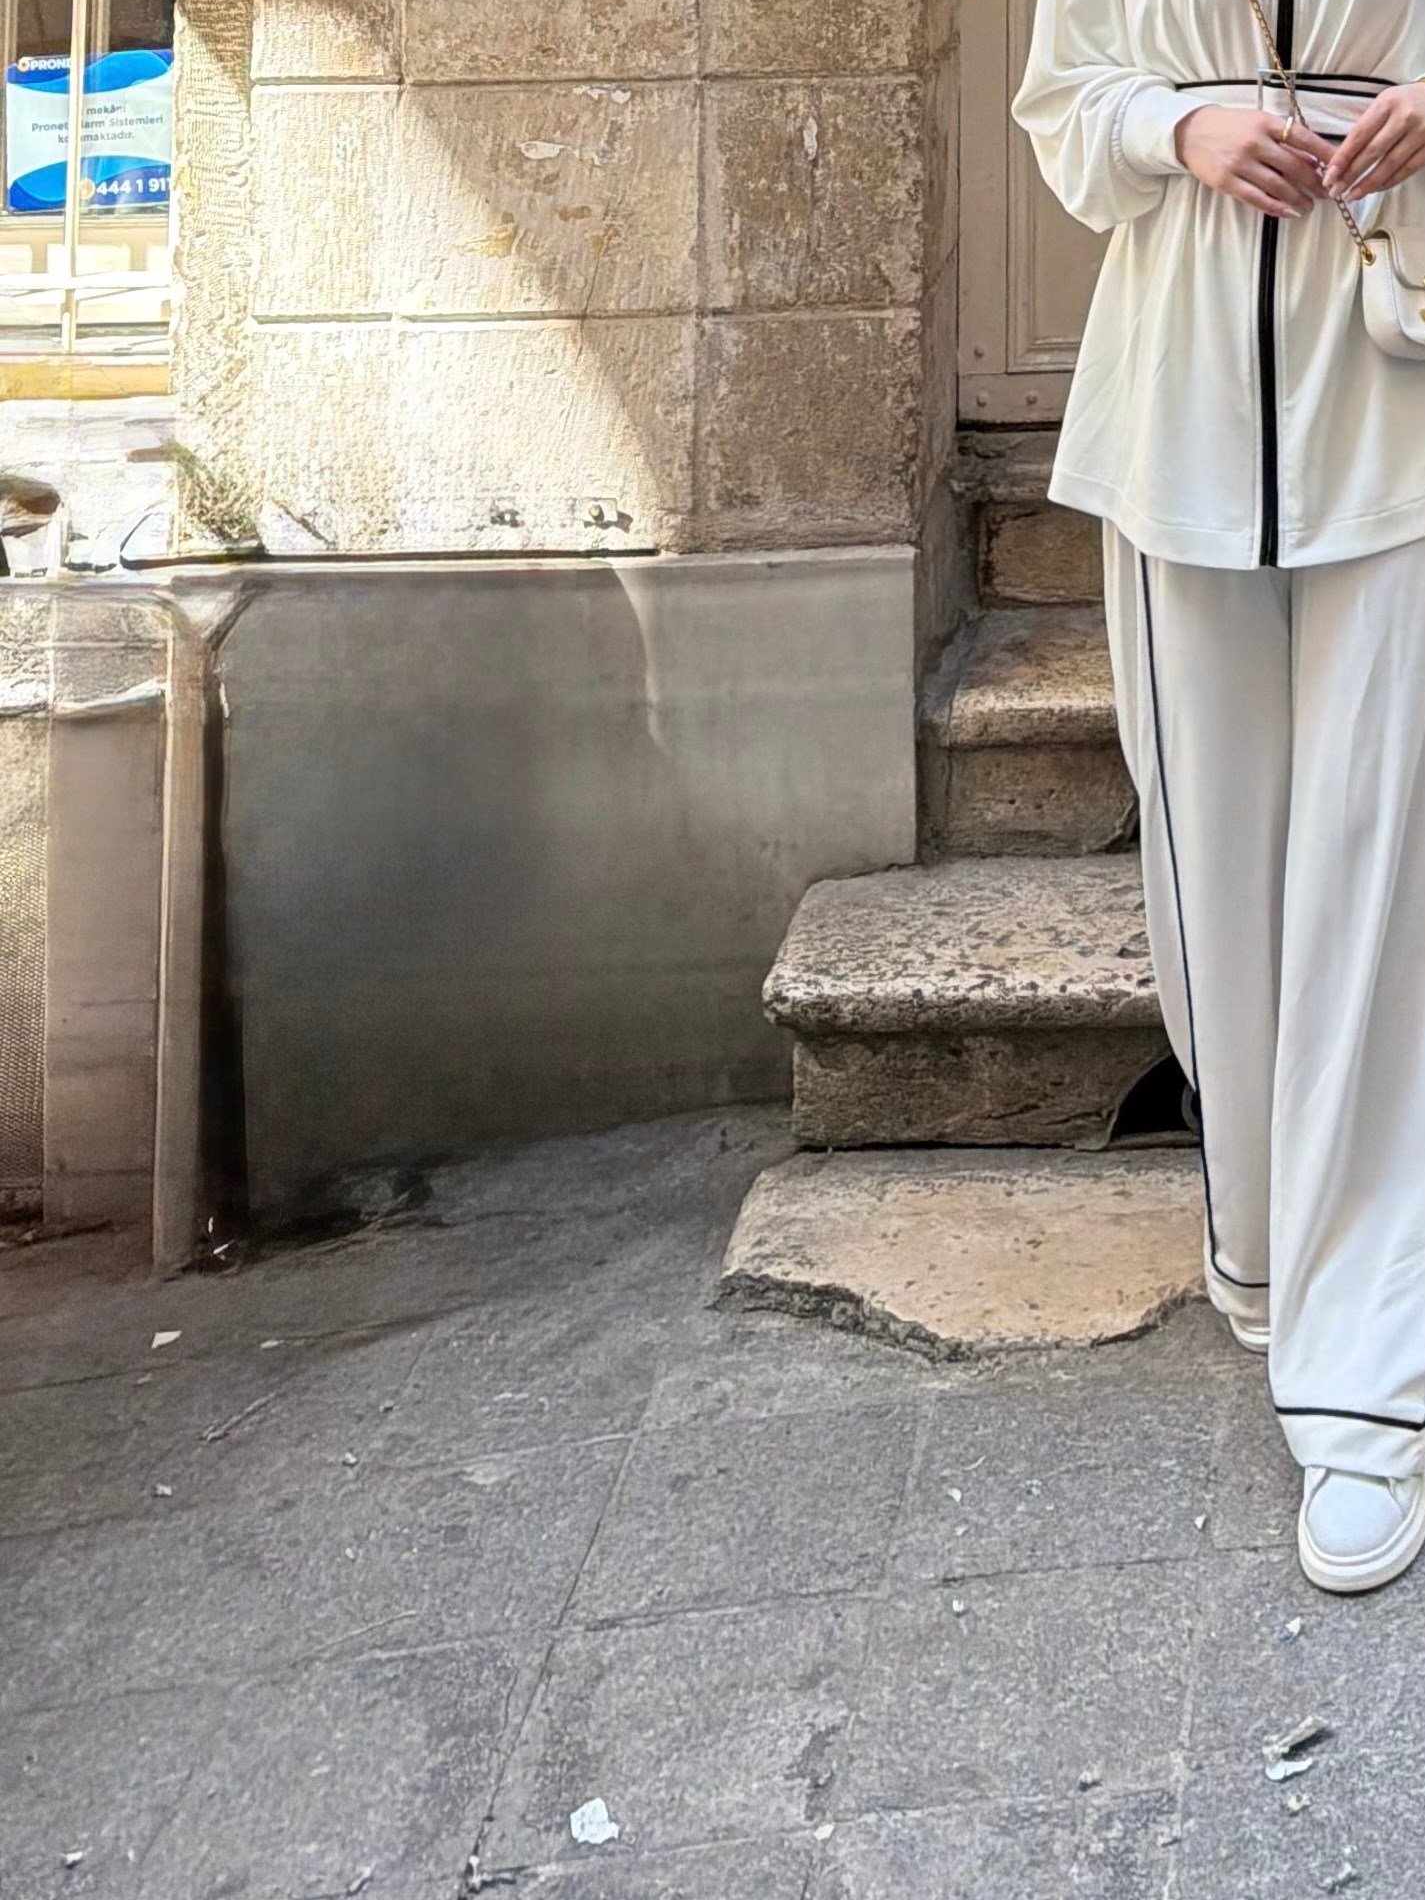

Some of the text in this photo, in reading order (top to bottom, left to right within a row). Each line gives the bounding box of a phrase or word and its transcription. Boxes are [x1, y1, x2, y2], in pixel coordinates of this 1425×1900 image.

[81, 118, 105, 129] larm
[96, 179, 132, 195] 444
[135, 178, 143, 193] 1
